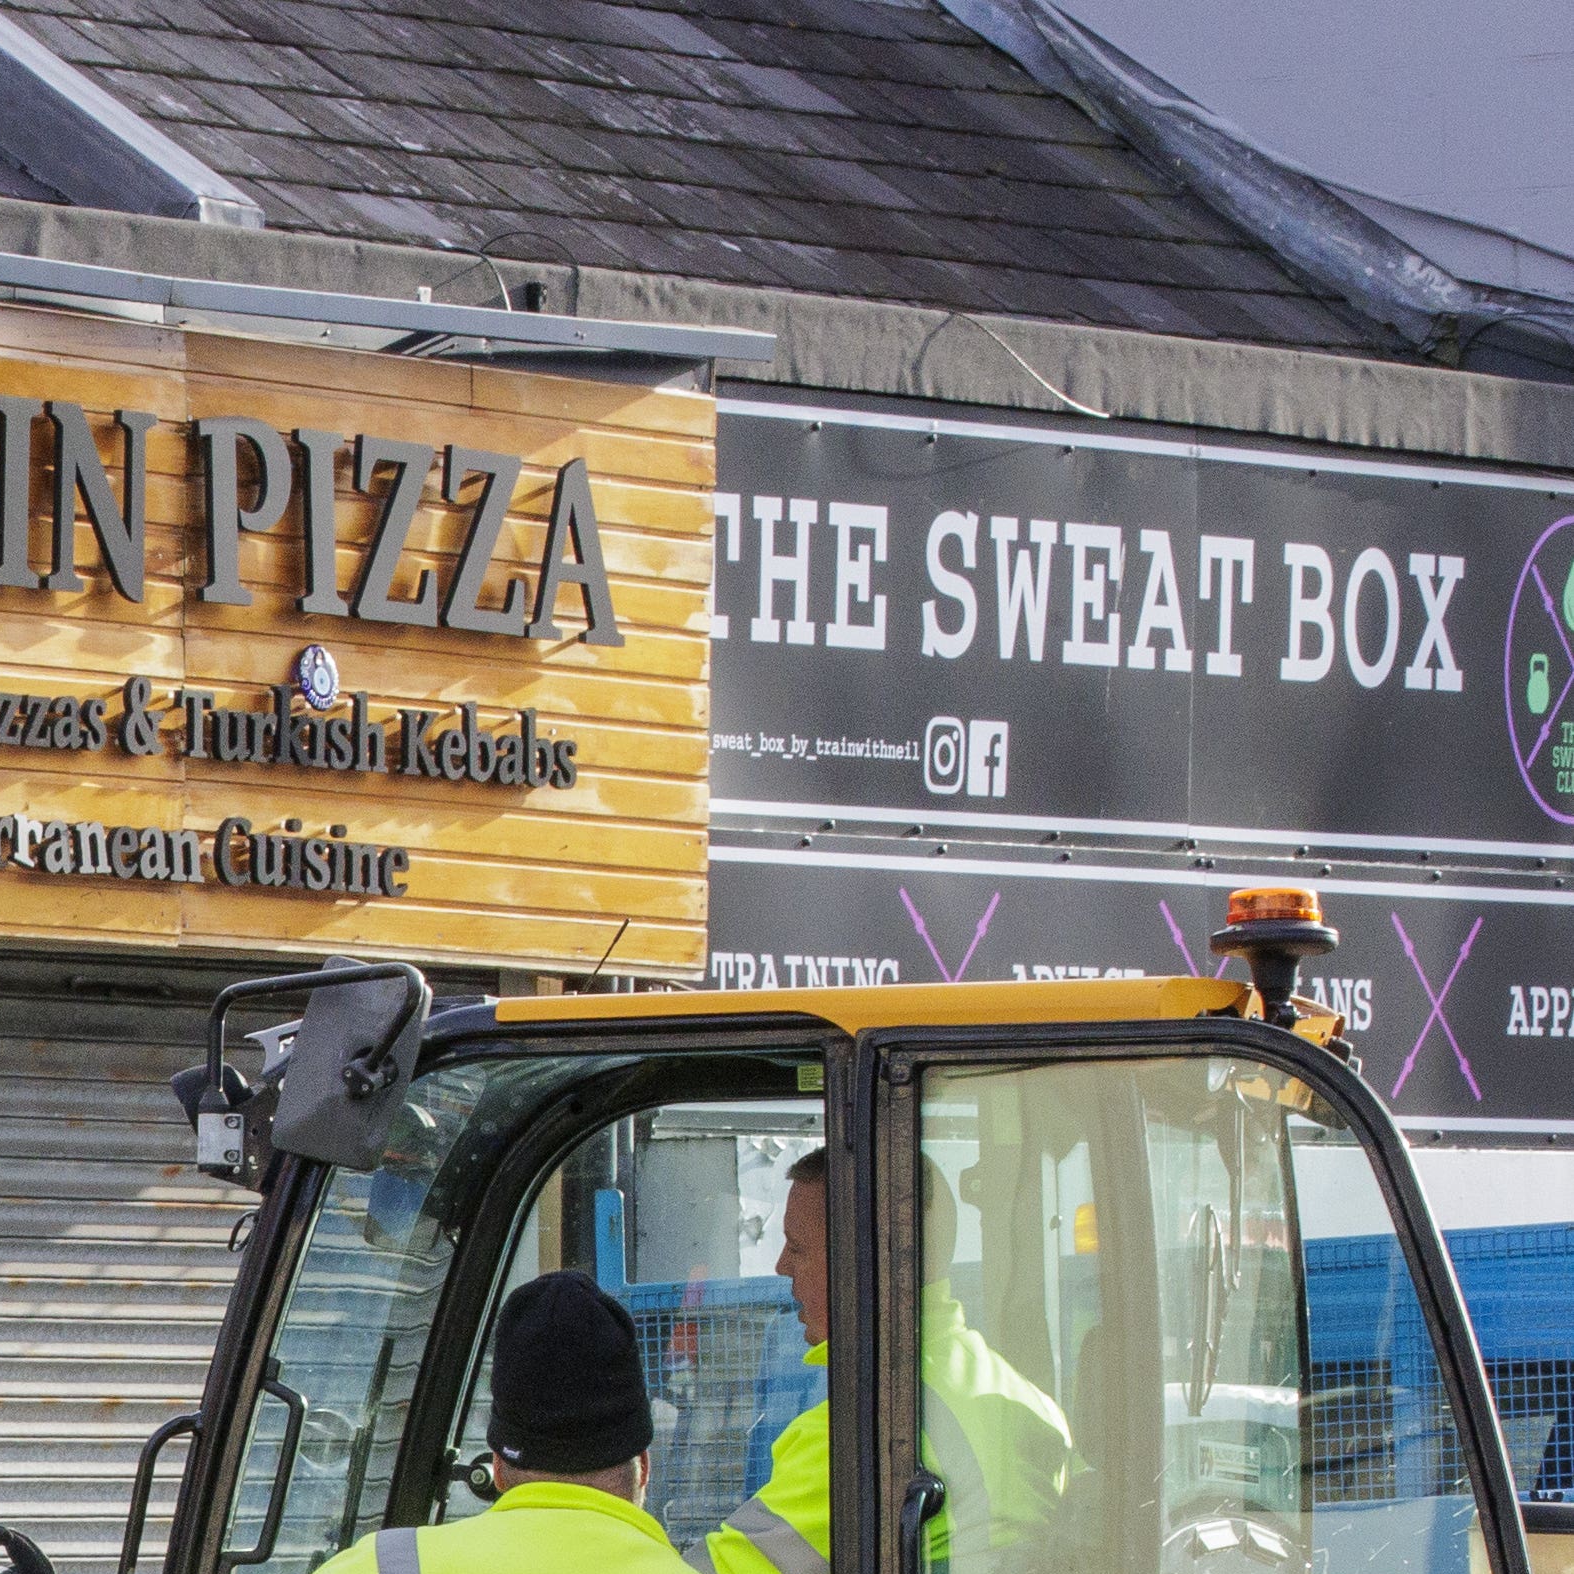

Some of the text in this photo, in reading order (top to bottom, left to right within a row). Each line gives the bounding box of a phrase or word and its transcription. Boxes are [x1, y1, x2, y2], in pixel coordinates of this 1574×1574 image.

[189, 415, 625, 647] PIZZA
[711, 492, 1464, 692] THE SWEAT BOX
[122, 675, 165, 757] &
[182, 682, 388, 773] Turkish
[399, 703, 578, 790] Kebabs
[213, 816, 410, 898] Cuisine
